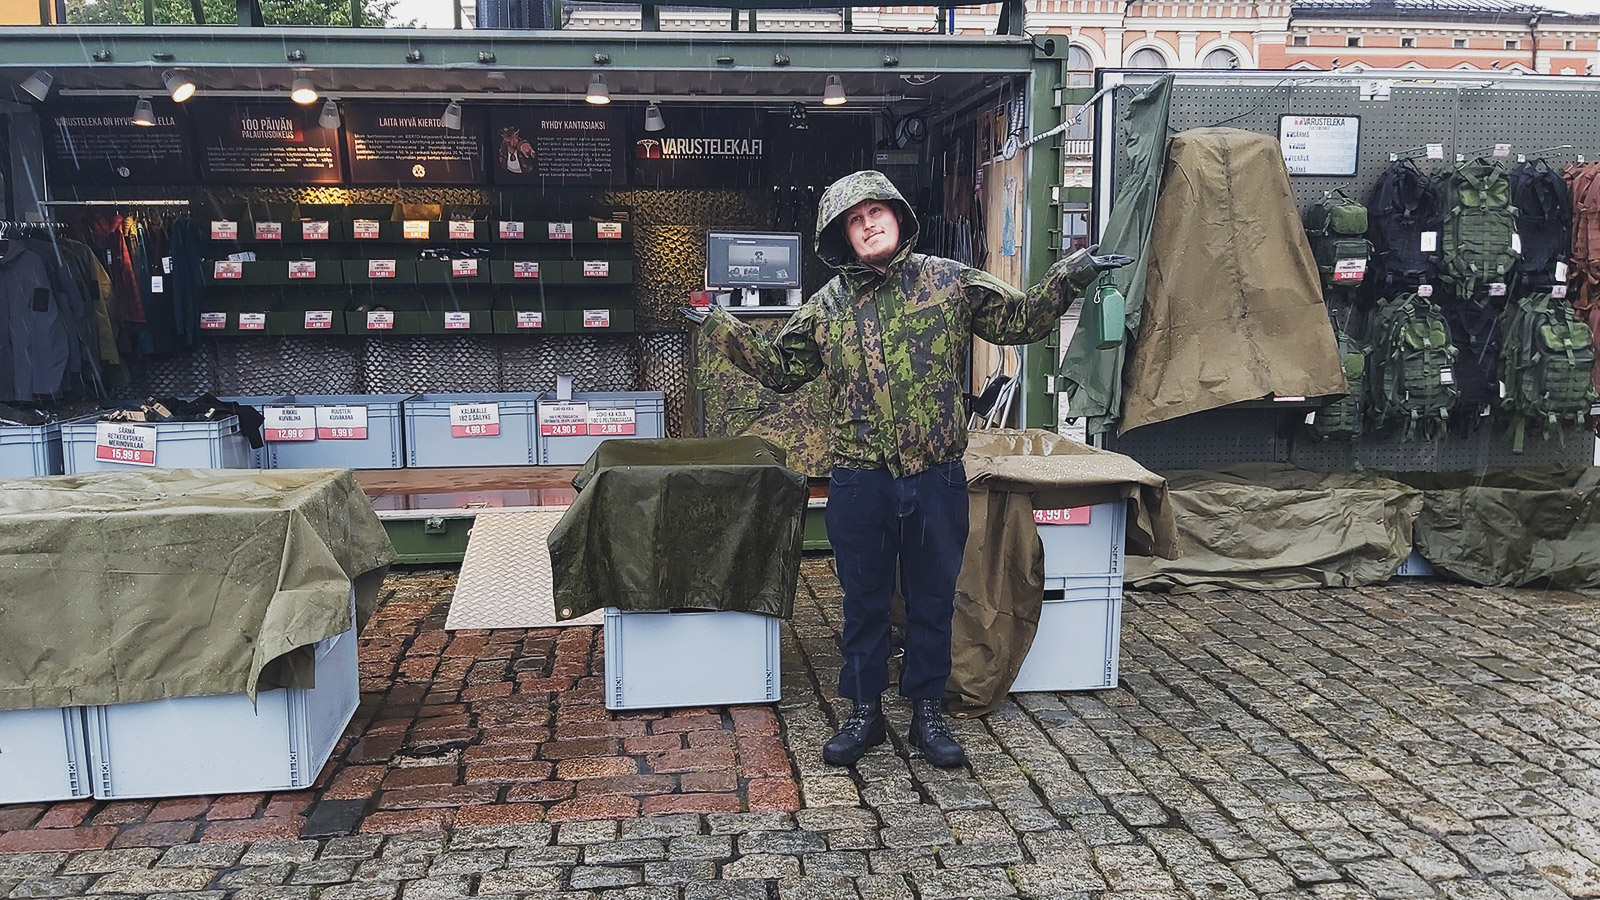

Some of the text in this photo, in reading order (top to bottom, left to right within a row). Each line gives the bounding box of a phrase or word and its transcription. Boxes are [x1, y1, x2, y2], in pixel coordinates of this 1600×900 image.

[54, 117, 102, 126] VARUSTELEKA
[103, 117, 113, 126] ON
[114, 117, 135, 126] HYVIE
[241, 117, 293, 131] 100 PÄIVÄN
[379, 117, 399, 127] LAITA
[400, 116, 417, 128] HYVÄ
[541, 120, 606, 130] RYHDY KANTASIAKSI
[1303, 118, 1345, 126] VARUSTELEKA
[241, 130, 294, 139] PALAUTUSOIKEUS
[660, 138, 763, 155] VARUSTELEKA.FI
[277, 429, 304, 439] 12,99 €
[331, 428, 354, 438] 9,99 €
[465, 424, 487, 435] 4,99 €
[552, 425, 577, 434] 24,90 €
[601, 424, 616, 434] 2,99
[108, 439, 144, 449] MERINOVILLAA
[111, 448, 141, 461] 15,99 €
[1063, 508, 1072, 521] €
